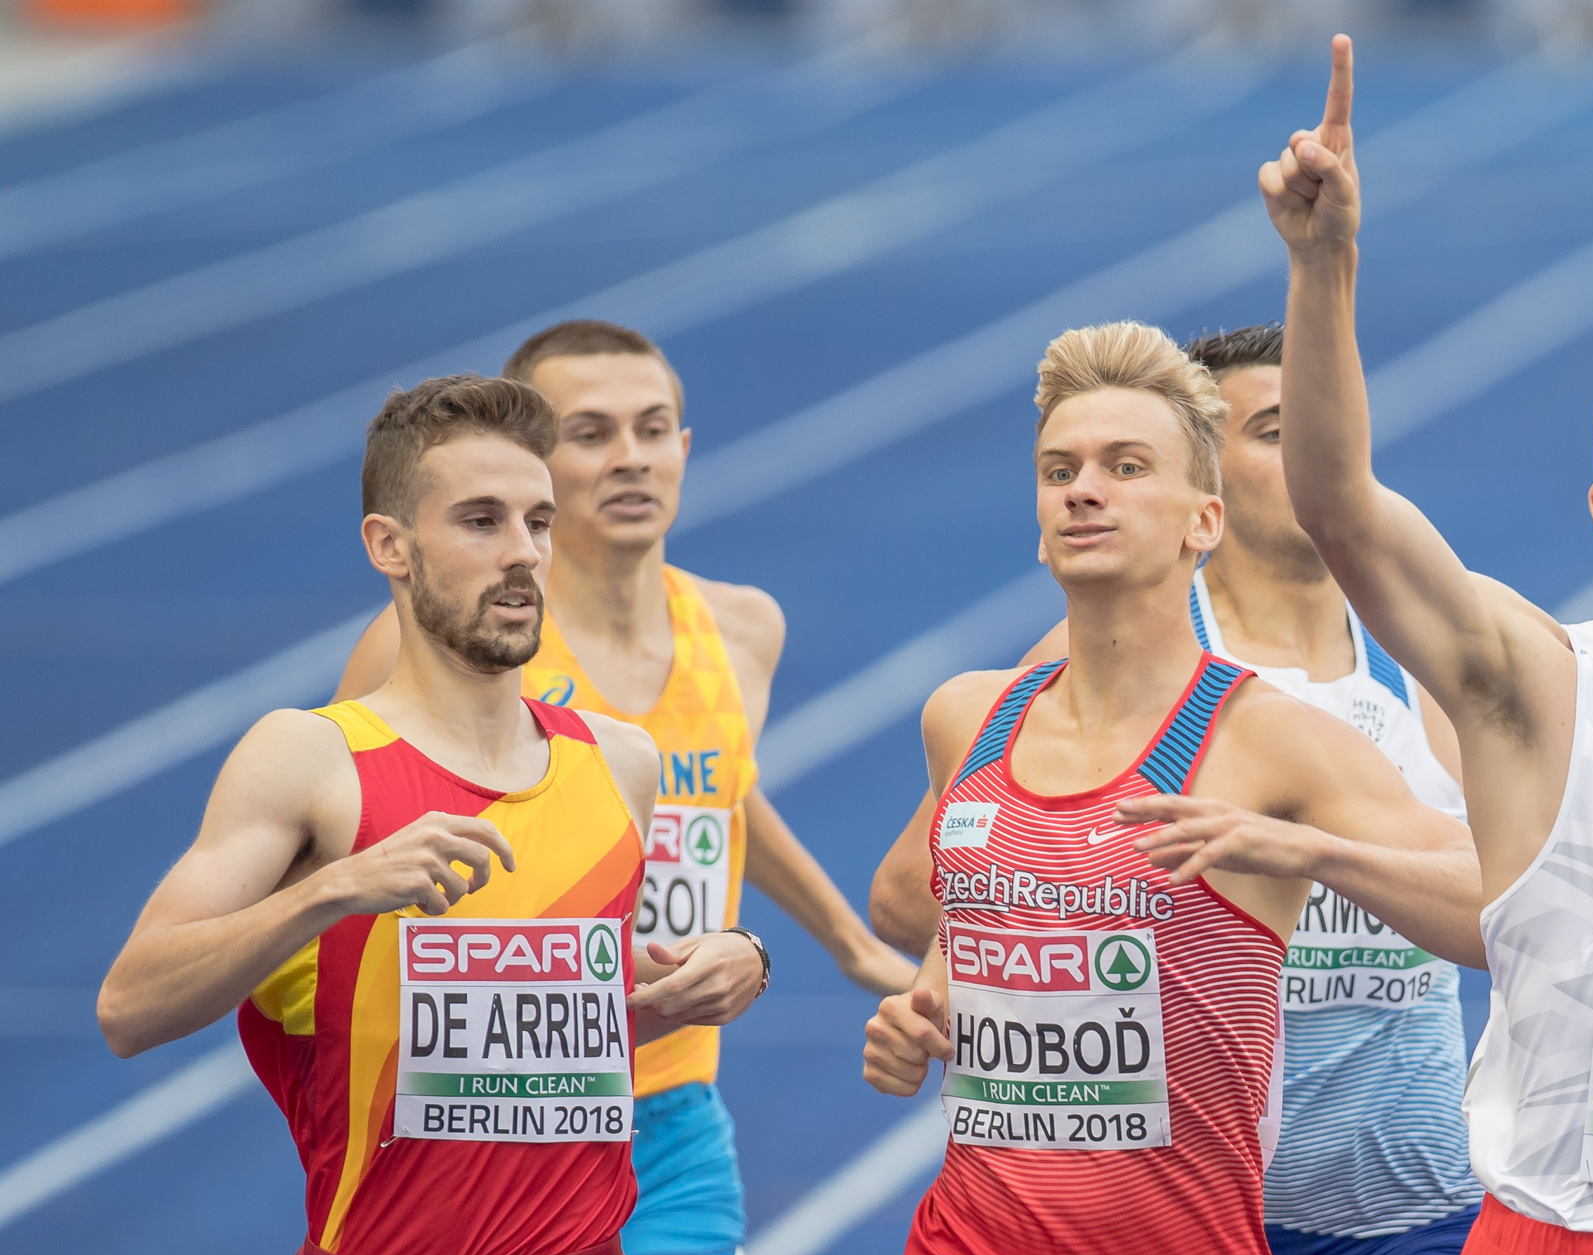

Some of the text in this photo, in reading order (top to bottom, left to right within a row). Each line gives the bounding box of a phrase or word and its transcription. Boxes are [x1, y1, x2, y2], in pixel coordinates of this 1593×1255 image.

[412, 933, 578, 973] SPAR
[953, 935, 1085, 984] SPAR
[1287, 948, 1332, 966] RUN
[1366, 971, 1432, 1003] 2018
[410, 992, 625, 1059] DE ARRIBA
[956, 1007, 1151, 1075] HODBOĎ
[459, 1078, 465, 1094] I
[472, 1078, 518, 1094] RUN
[982, 1081, 988, 1098] I
[990, 1082, 1026, 1101] RUN
[423, 1104, 624, 1135] BERLIN 2018
[953, 1105, 1147, 1142] BERLIN 2018
